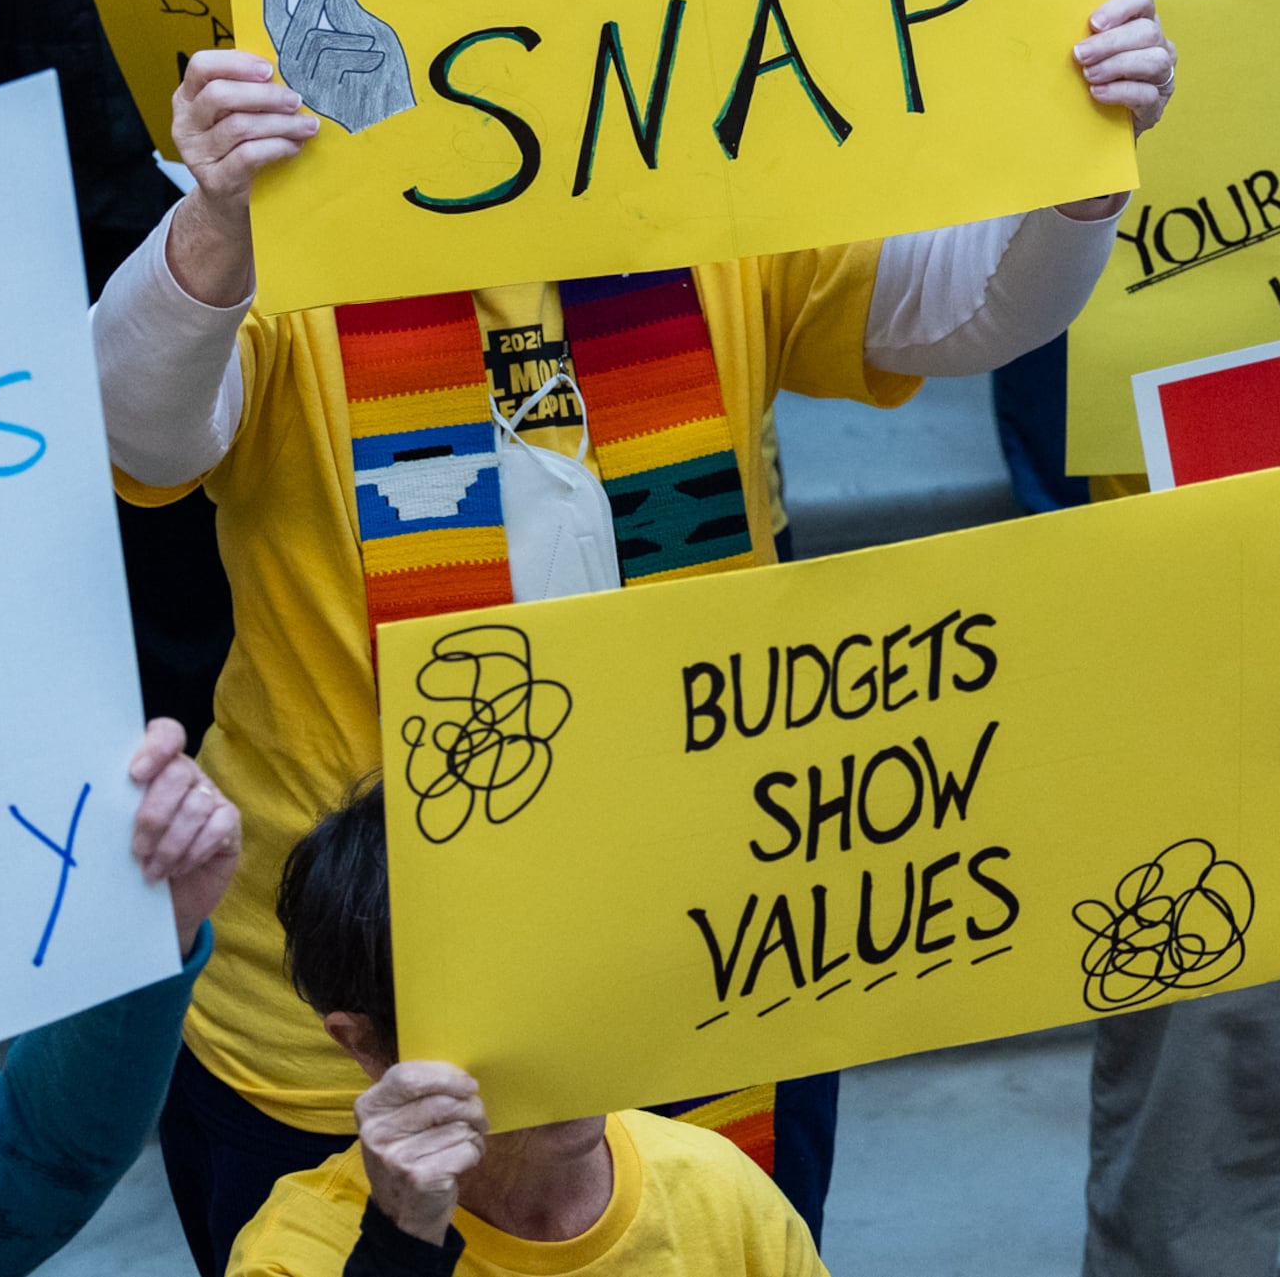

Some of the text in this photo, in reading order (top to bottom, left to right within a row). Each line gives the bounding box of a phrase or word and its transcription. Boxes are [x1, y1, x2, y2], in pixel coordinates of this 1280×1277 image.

[681, 609, 999, 754] BUDGETS
[748, 721, 1000, 863] SHOW
[687, 846, 1020, 1003] VALUES
